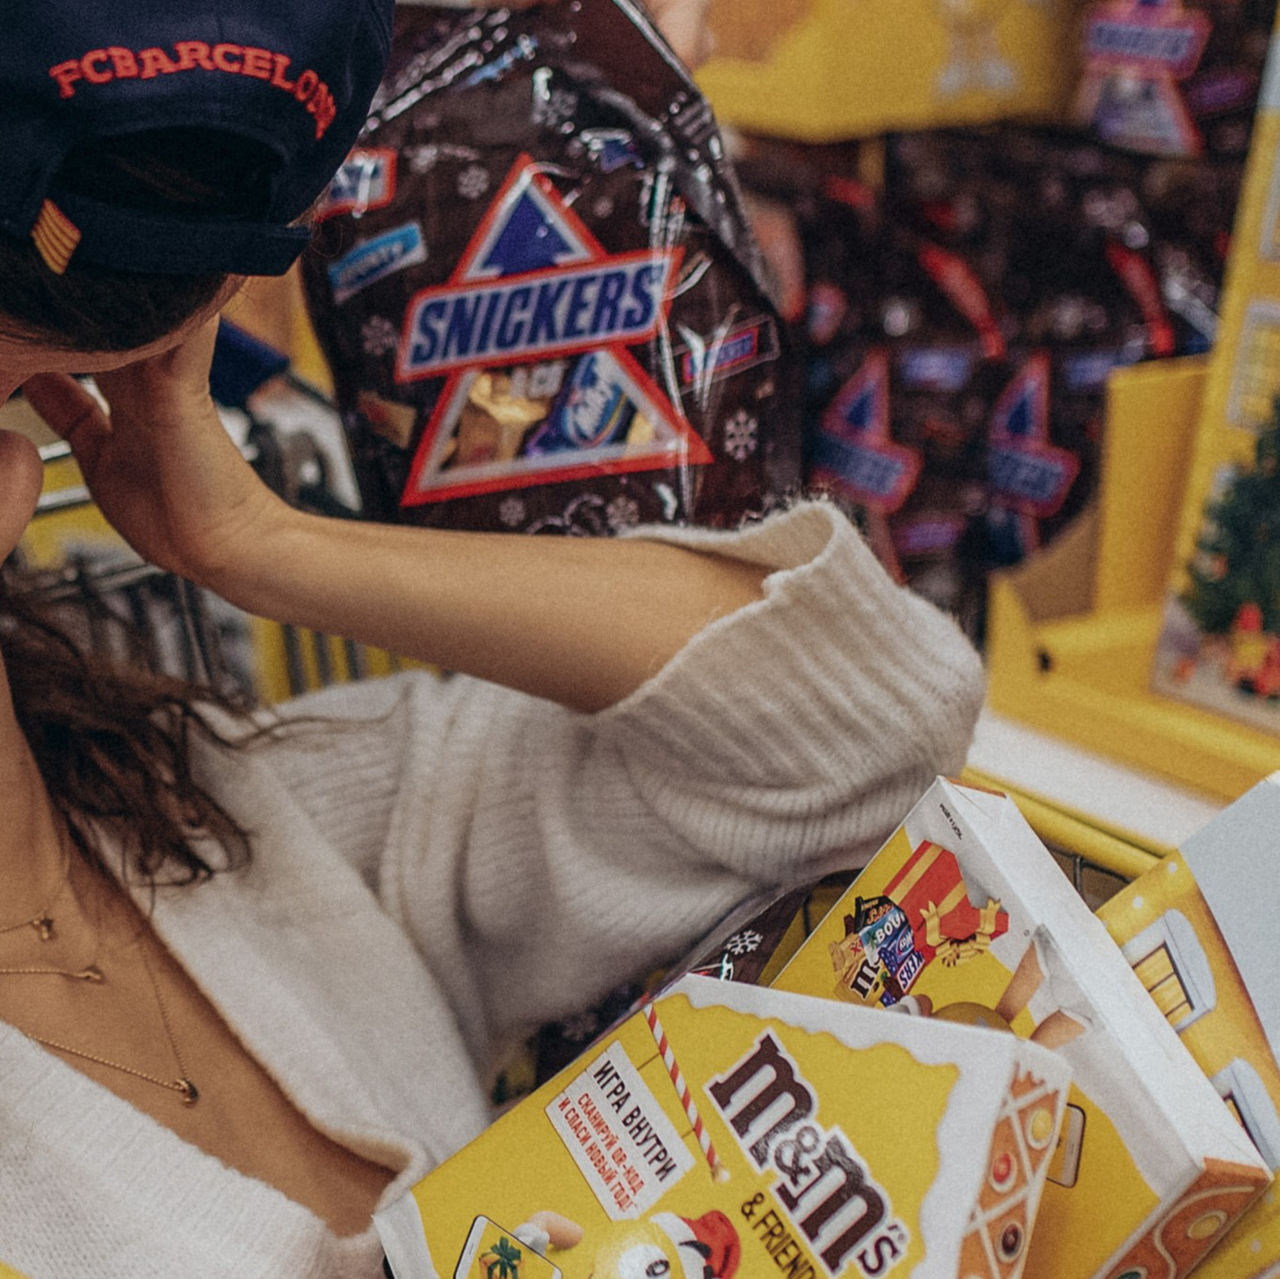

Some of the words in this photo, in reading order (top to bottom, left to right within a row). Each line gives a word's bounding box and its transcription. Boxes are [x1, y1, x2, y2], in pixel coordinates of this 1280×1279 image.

[410, 262, 665, 368] SNICKERS
[558, 1096, 572, 1112] И
[593, 1060, 631, 1114] ИГРА
[622, 1105, 677, 1182] ВНУТРИ
[564, 1107, 592, 1146] СПАСИ
[577, 1092, 619, 1152] СКАНИРУЙ
[611, 1147, 645, 1196] QR-КОД
[585, 1142, 618, 1185] НОВЫЙ
[740, 1192, 765, 1222] &
